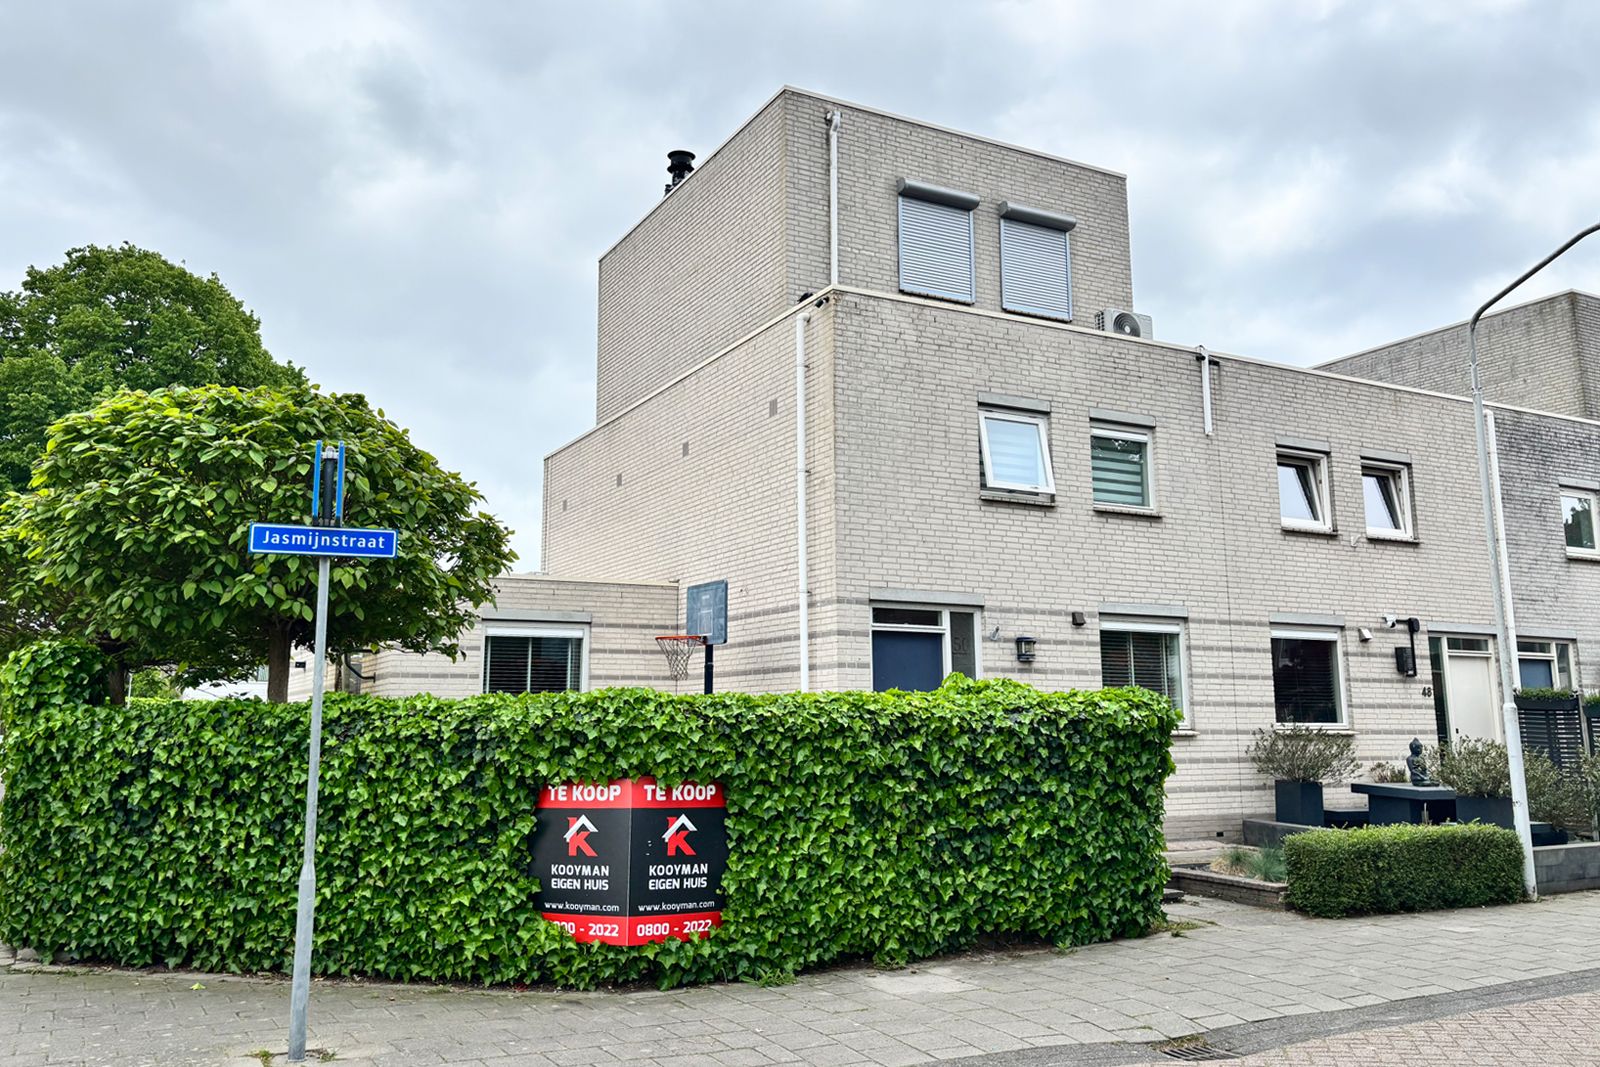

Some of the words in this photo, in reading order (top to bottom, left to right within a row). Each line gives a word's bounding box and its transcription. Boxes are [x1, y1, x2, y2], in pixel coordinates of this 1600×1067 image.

[262, 530, 385, 550] Jasmijnstraat
[1421, 686, 1433, 698] 48
[548, 785, 568, 801] TE
[572, 784, 622, 801] KOOP
[643, 784, 667, 801] TE
[672, 784, 716, 801] KOOP
[551, 864, 610, 877] KOOYMAN
[649, 863, 709, 877] KOOYMAN
[551, 878, 581, 890] EIGEN
[584, 879, 609, 891] HUIS
[648, 878, 680, 891] EIGEN
[683, 877, 708, 889] HUIS
[544, 901, 620, 913] www.kooyman.com
[638, 900, 715, 913] www.kooyman.com
[588, 923, 619, 937] 2022
[636, 922, 670, 937] 0800
[683, 919, 712, 934] 2022
